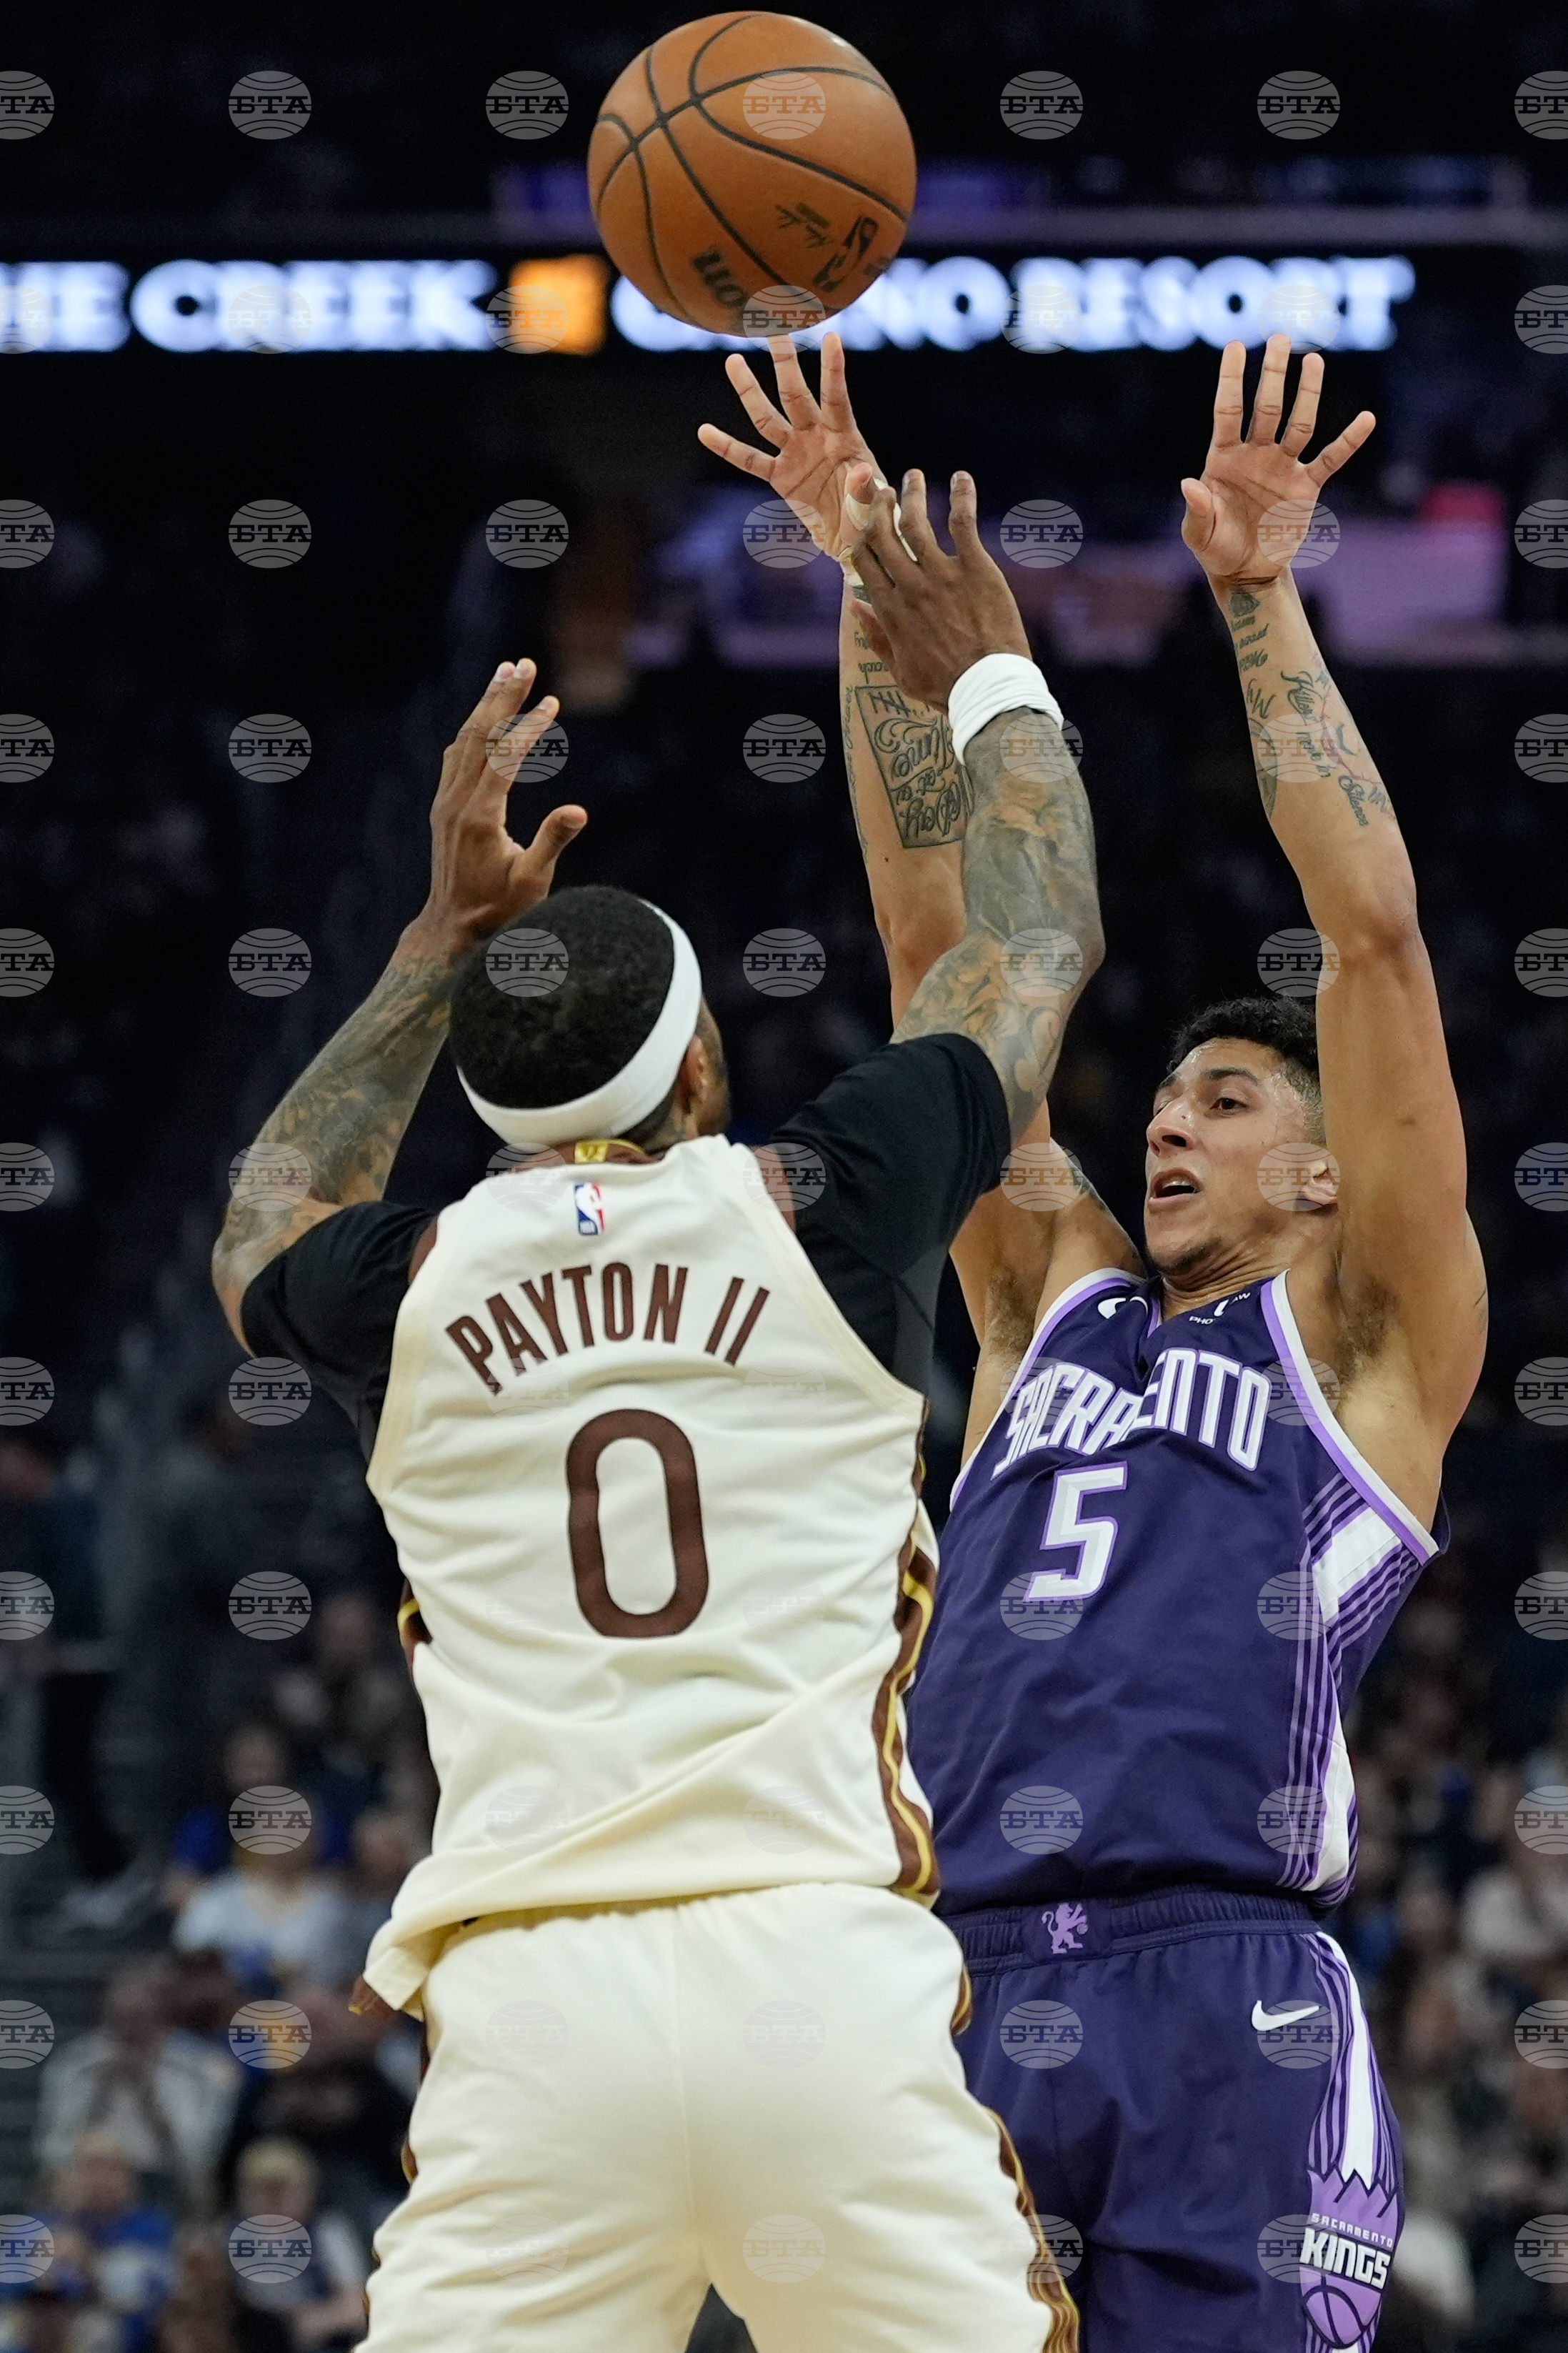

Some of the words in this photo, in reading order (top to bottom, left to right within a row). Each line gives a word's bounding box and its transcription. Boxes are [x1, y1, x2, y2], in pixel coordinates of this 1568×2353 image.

[445, 1262, 688, 1396] PAYTON
[704, 1276, 770, 1368] II
[991, 1348, 1272, 1472] SACRAENTO
[566, 1408, 709, 1639] 0
[1023, 1461, 1127, 1602] 5
[1299, 2227, 1391, 2289] KINGS
[1311, 2212, 1393, 2248] SACRAMENTO
